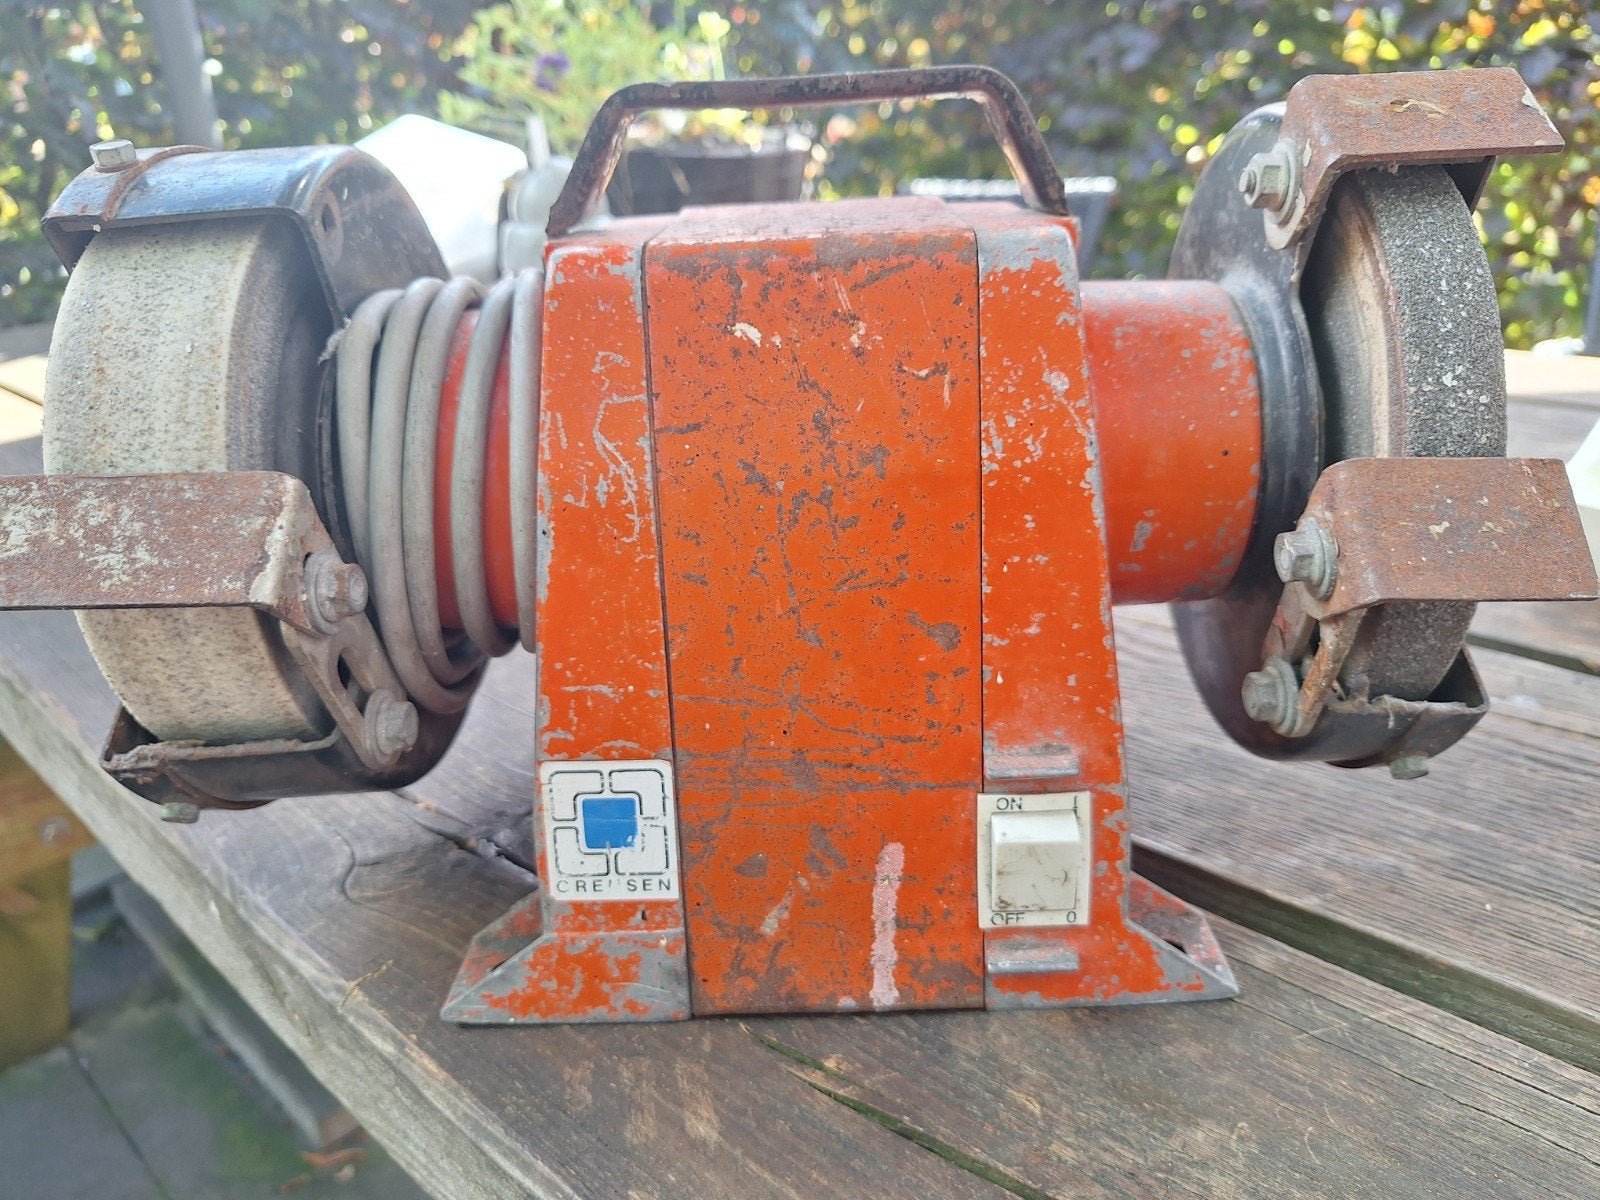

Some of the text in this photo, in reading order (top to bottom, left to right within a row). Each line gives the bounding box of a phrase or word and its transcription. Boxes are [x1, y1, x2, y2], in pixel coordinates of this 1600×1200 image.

[996, 797, 1022, 810] ON
[557, 879, 671, 892] CRESEN
[991, 912, 1025, 926] OFF
